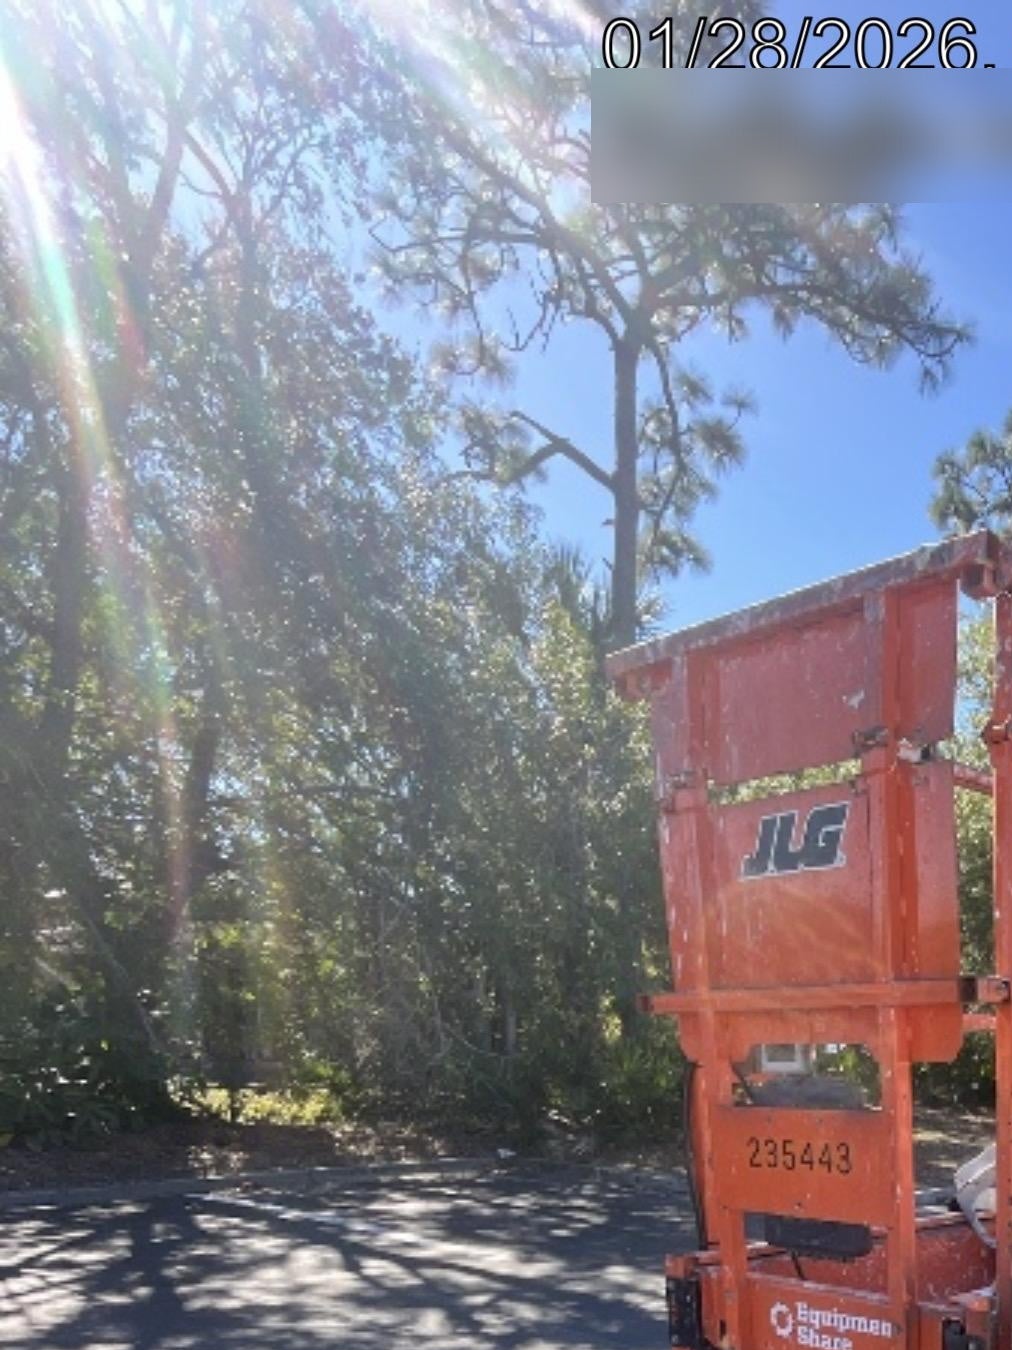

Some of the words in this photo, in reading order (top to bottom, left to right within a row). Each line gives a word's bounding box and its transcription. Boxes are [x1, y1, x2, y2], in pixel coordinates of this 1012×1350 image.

[739, 801, 850, 880] JLG
[746, 1136, 853, 1174] 235443
[796, 1301, 895, 1338] Equipmen
